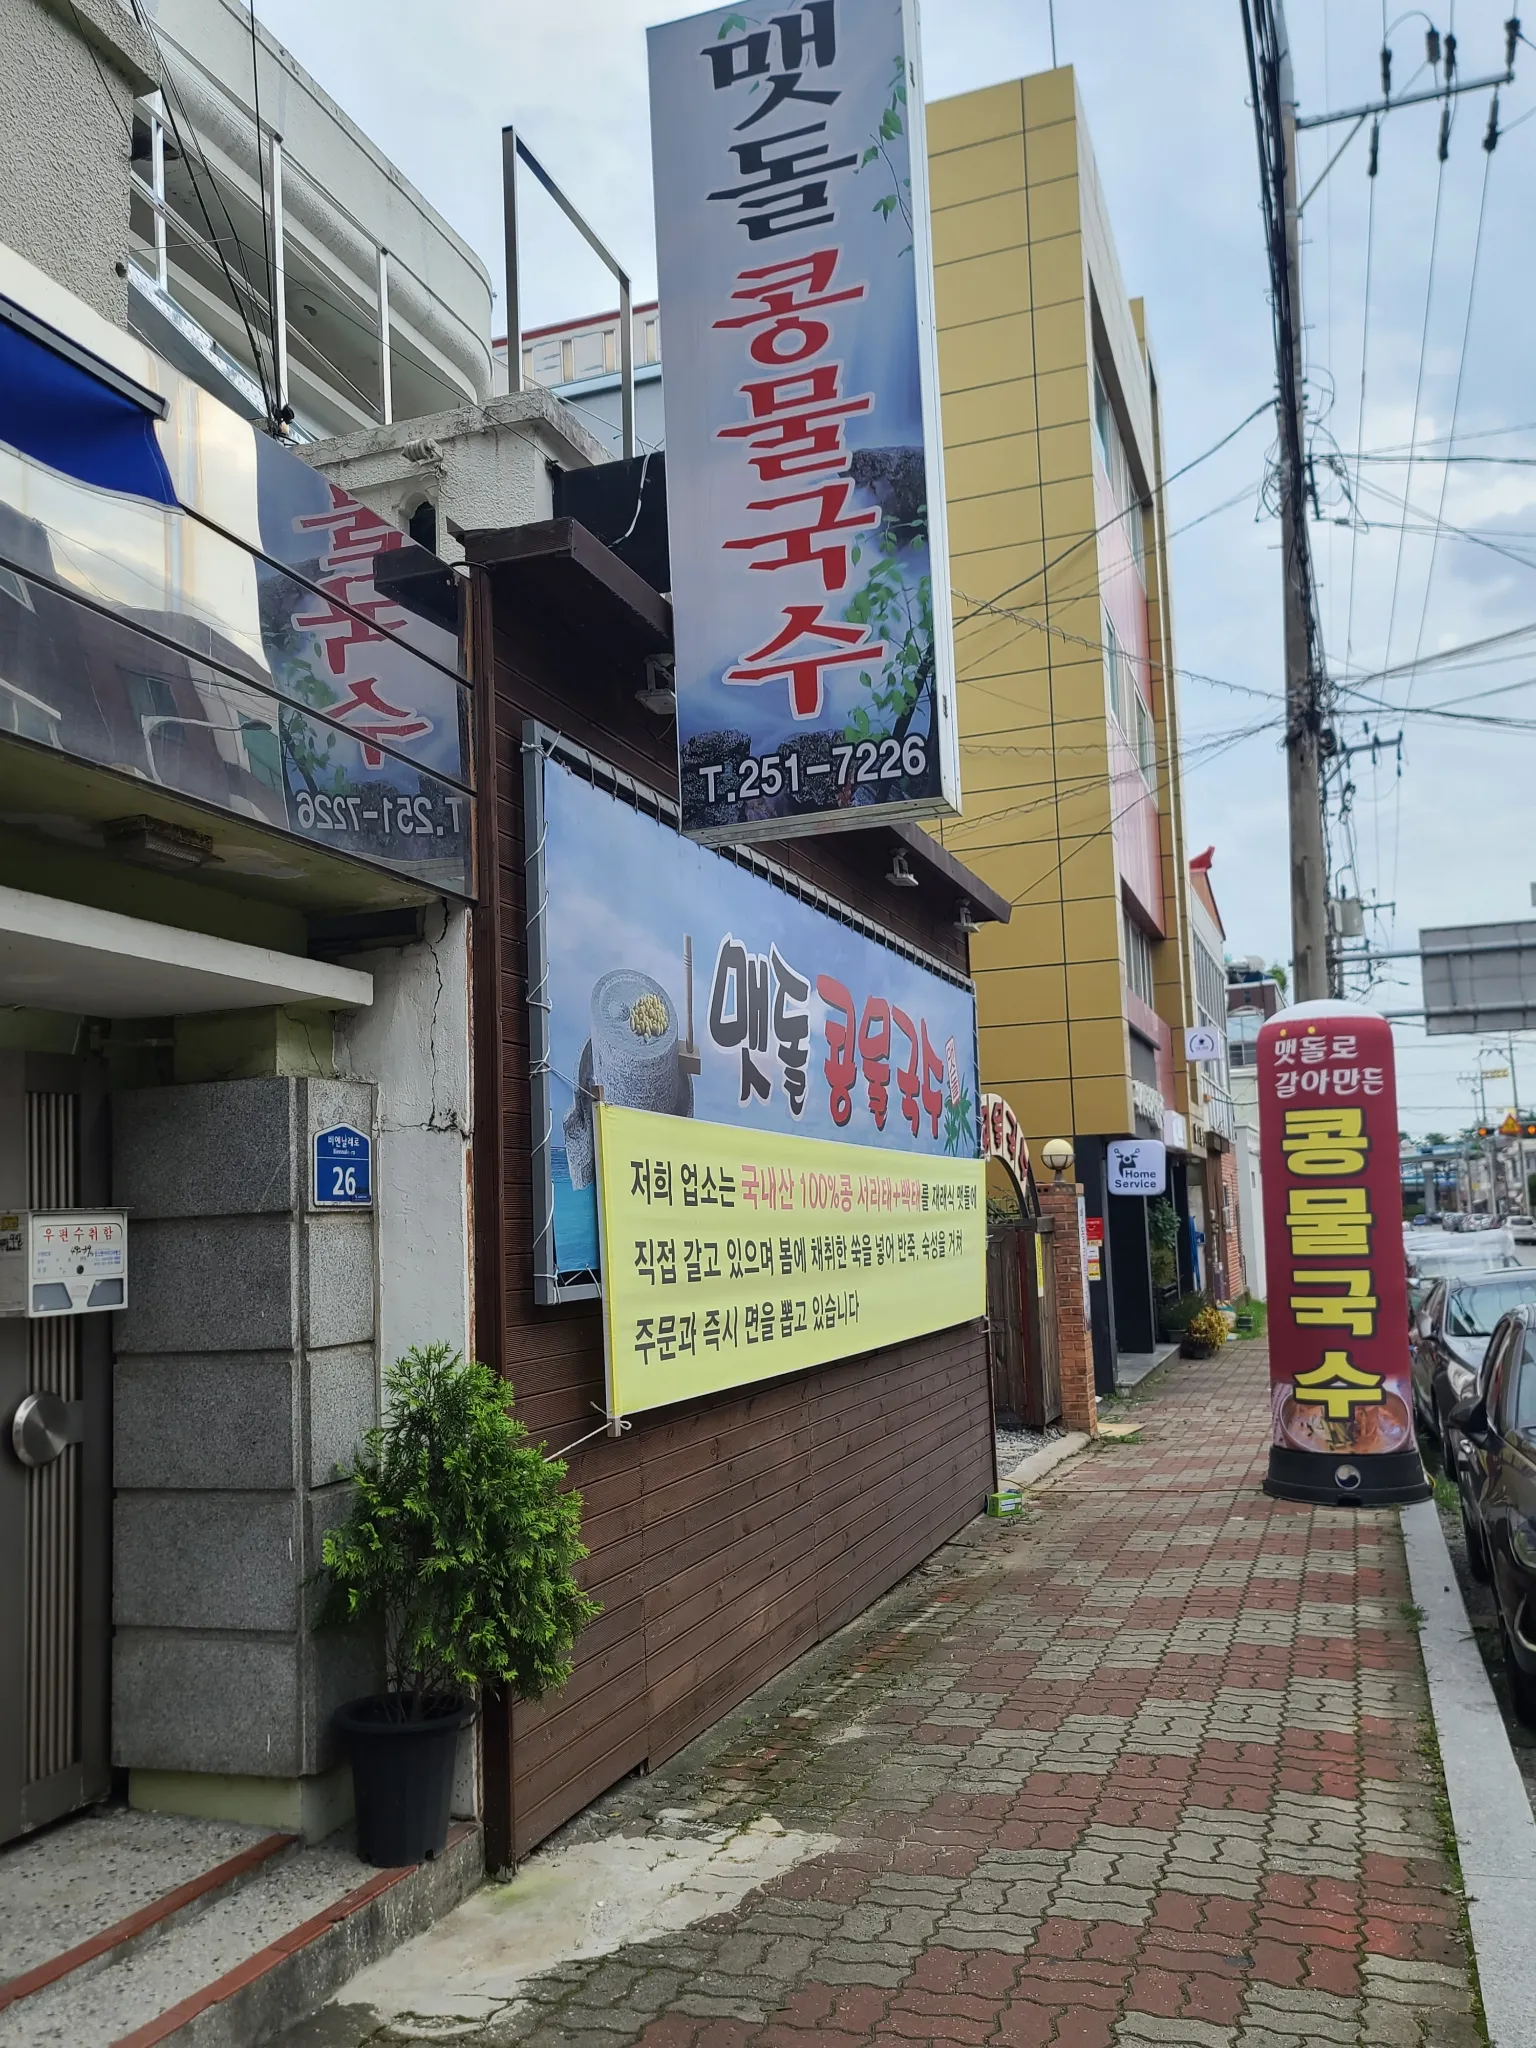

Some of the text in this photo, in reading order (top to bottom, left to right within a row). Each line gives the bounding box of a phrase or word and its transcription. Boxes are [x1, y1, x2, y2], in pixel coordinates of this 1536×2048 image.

[700, 0, 884, 716] 맷돌 콩물국수
[699, 736, 926, 803] T.251-7226
[708, 936, 944, 1140] 맷돌 콩물국수
[1274, 1034, 1359, 1067] 맷돌로
[1274, 1067, 1384, 1099] 갈아만든
[328, 1133, 360, 1148] 비엔날레로
[333, 1166, 356, 1196] 26
[630, 1158, 673, 1206] 저희
[681, 1163, 736, 1207] 업소는
[741, 1164, 794, 1210] 국내산
[800, 1171, 853, 1213] 100%콩
[932, 1183, 955, 1212] 재래식
[956, 1184, 977, 1211] 맷돌에
[1115, 1179, 1157, 1188] Service
[1125, 1169, 1157, 1179] Home
[634, 1228, 963, 1286] 직접 갈고 있으며 봄에 채취한 쑥을 넣어 반죽, 숙성을 거쳐
[1282, 1107, 1382, 1418] 콩물국수
[634, 1289, 860, 1366] 주문과 즉시 면을 뽑고 있습니다
